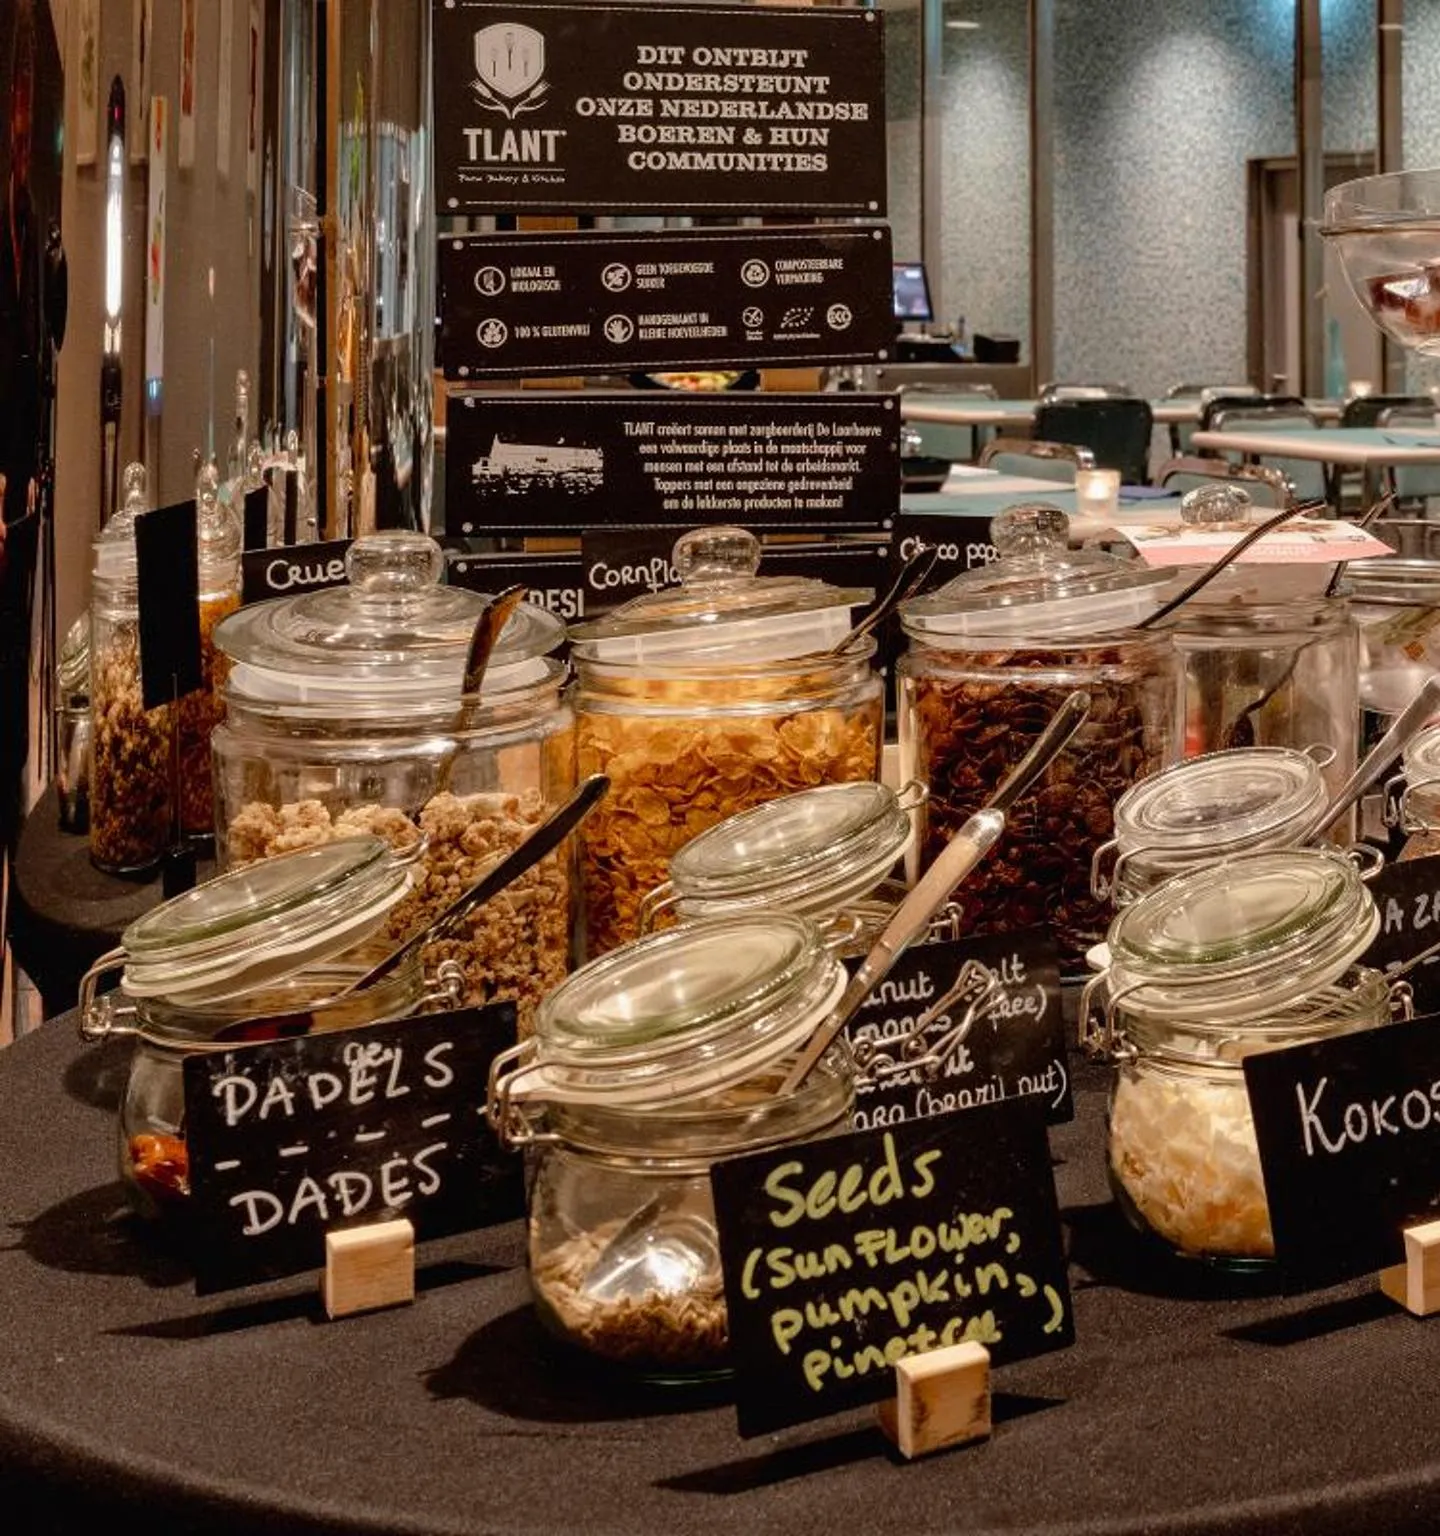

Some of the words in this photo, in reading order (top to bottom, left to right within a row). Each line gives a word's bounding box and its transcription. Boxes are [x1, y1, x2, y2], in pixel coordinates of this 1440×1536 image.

[636, 45, 686, 65] DIT
[692, 47, 809, 69] ONTBIJT
[622, 71, 831, 95] ONDERSTEUNT
[575, 97, 654, 117] ONZE
[659, 99, 869, 121] NEDERLANDSE
[462, 127, 560, 163] TLANT
[617, 124, 736, 146] BOEREN
[741, 127, 763, 145] &
[768, 127, 830, 147] HUN
[627, 151, 829, 172] COMMUNITIES
[635, 264, 657, 275] GEEN
[514, 326, 531, 338] 100
[624, 422, 655, 436] TLANT
[694, 425, 727, 436] samen
[728, 424, 748, 436] met
[816, 423, 830, 436] De
[639, 444, 658, 454] een
[660, 440, 720, 457] volwaardige
[722, 440, 752, 457] plaats
[753, 441, 763, 454] in
[765, 440, 779, 454] de
[781, 440, 843, 457] maatschappij
[845, 444, 867, 454] voor
[644, 462, 682, 473] mensen
[684, 460, 704, 473] met
[706, 462, 725, 473] een
[727, 458, 763, 473] afstand
[765, 460, 779, 472] tot
[781, 458, 794, 472] de
[654, 477, 692, 494] Toppers
[694, 479, 714, 491] met
[716, 481, 735, 491] een
[663, 499, 680, 510] om
[681, 494, 695, 510] de
[696, 494, 742, 510] lekkerste
[744, 494, 792, 512] producten
[794, 497, 804, 510] te
[229, 1142, 448, 1236] DADES
